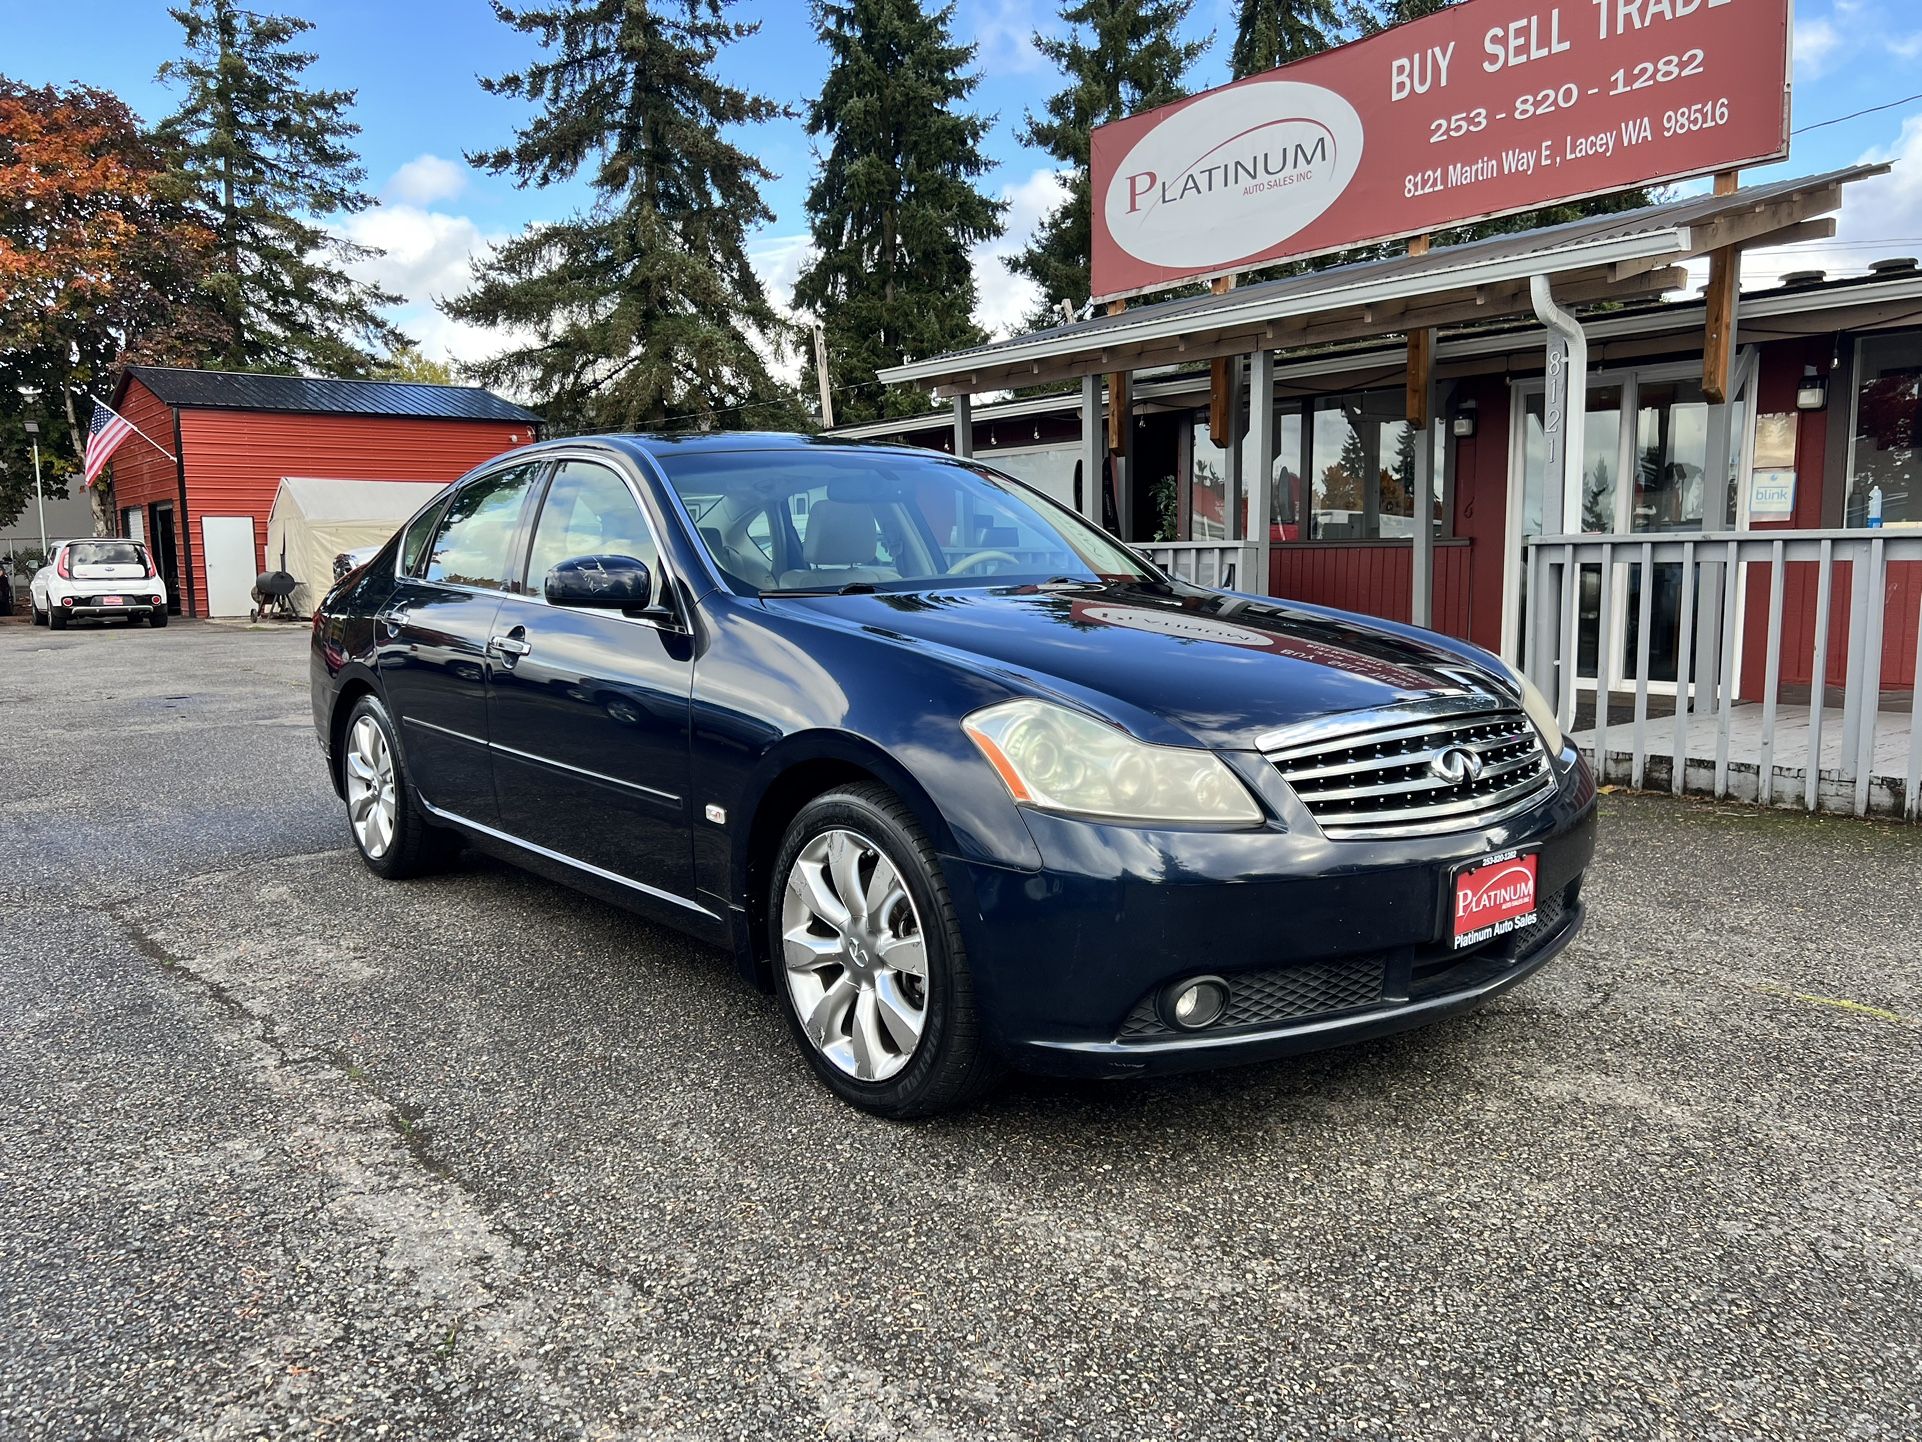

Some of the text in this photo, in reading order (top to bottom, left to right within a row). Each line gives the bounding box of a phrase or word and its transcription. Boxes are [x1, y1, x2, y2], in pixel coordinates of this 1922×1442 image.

[1391, 0, 1732, 102] BUY SELL TRA
[1429, 107, 1488, 143] 253
[1513, 83, 1579, 120] 820
[1608, 48, 1705, 96] 1282
[1125, 136, 1327, 215] PLATINUM
[1242, 170, 1313, 196] AUTO SALES INC
[1404, 167, 1444, 198] 8121
[1447, 156, 1497, 188] Martin
[1501, 148, 1537, 175] Way
[1565, 130, 1617, 157] Lacey
[1621, 116, 1653, 147] WA
[1663, 97, 1729, 138] 98516
[1544, 351, 1561, 464] 8121
[1755, 488, 1788, 501] blink
[1454, 913, 1537, 950] Platinum Auto Sales
[1456, 881, 1533, 917] PLATINUM
